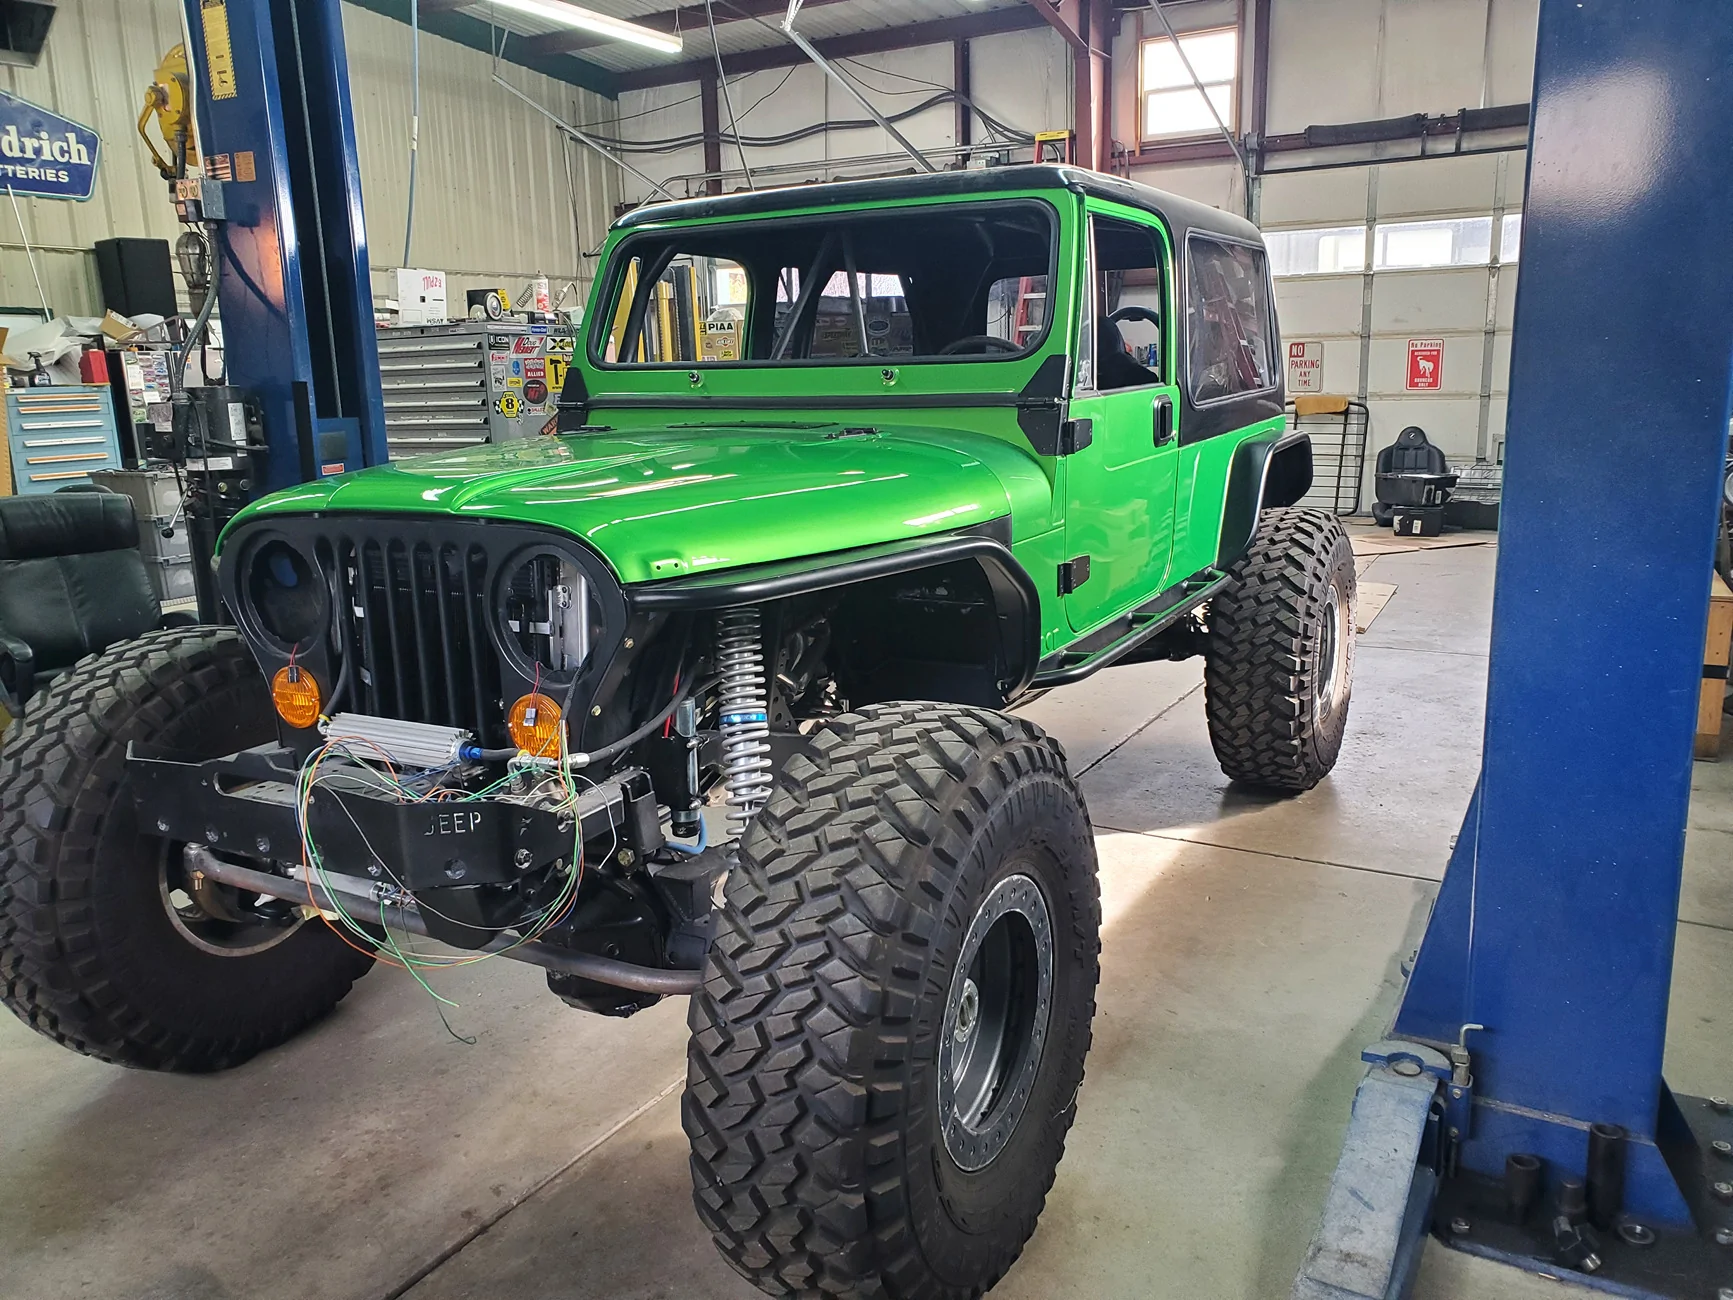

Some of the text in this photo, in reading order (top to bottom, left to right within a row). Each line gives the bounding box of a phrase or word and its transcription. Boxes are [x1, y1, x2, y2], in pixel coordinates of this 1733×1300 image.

[708, 322, 734, 331] PIAA
[1291, 344, 1304, 356] NO
[1291, 359, 1320, 369] PARKING
[1298, 379, 1311, 387] TIME
[505, 398, 515, 410] 8
[424, 811, 482, 836] JEEP
